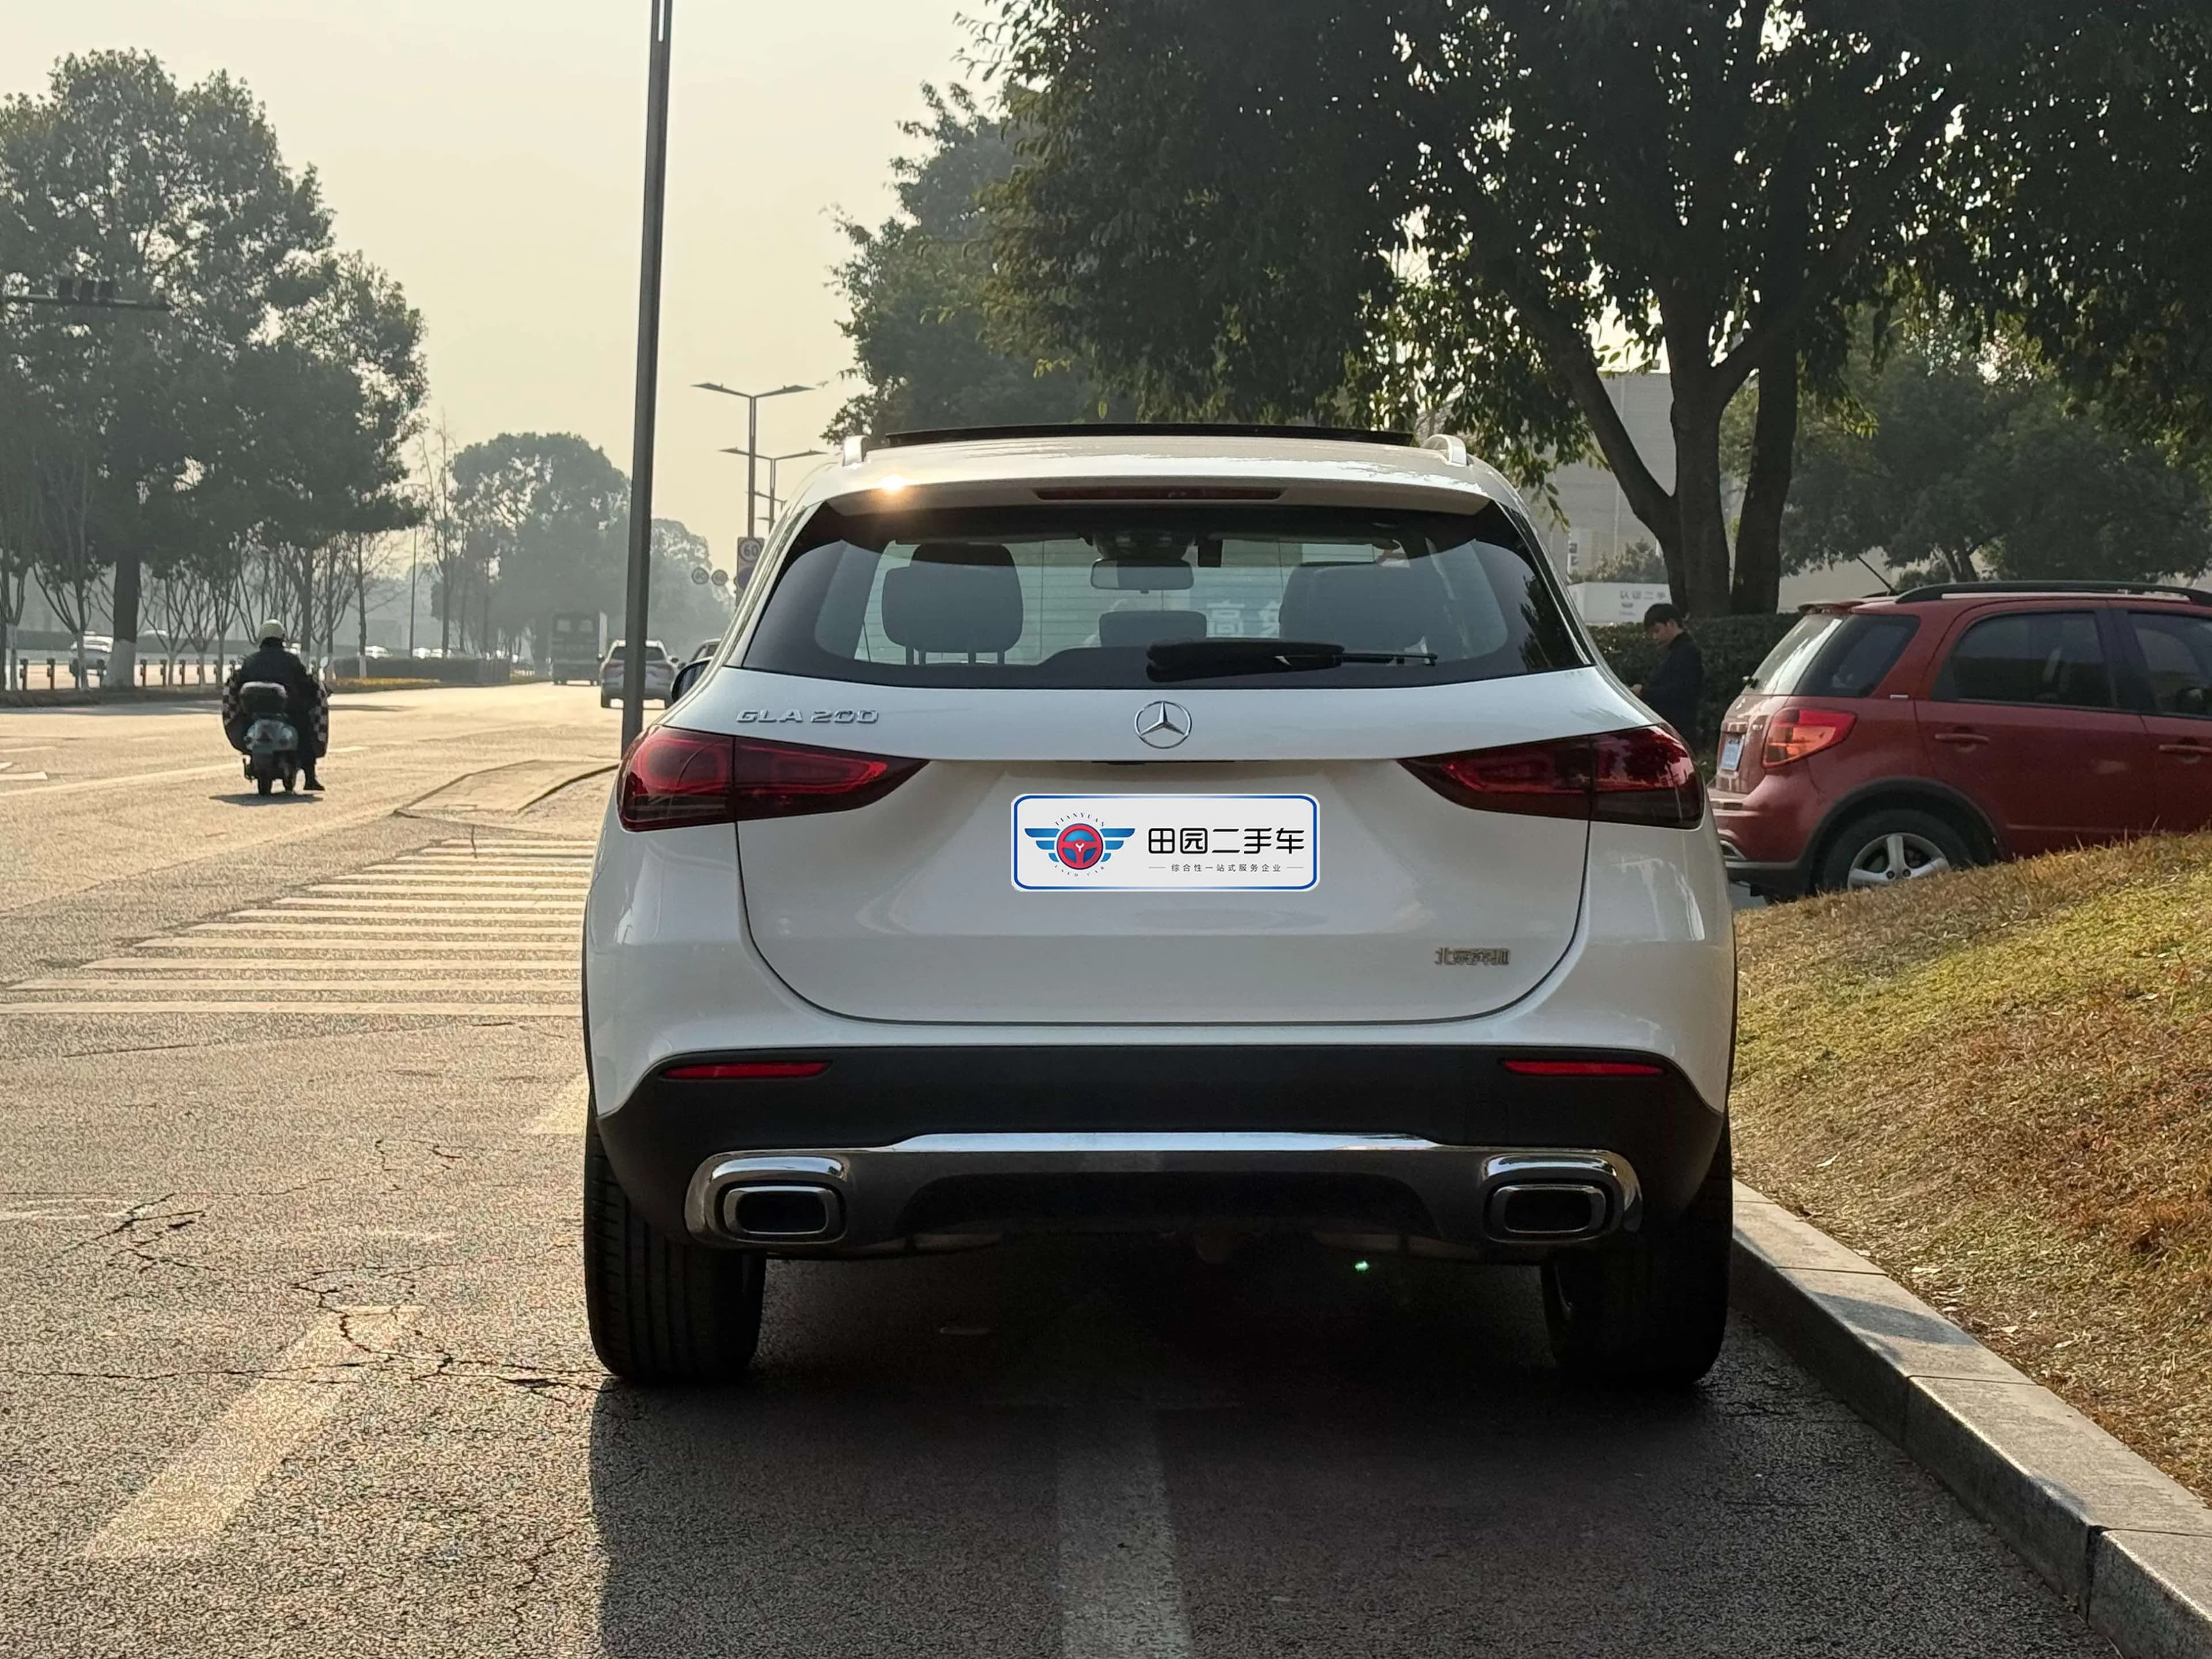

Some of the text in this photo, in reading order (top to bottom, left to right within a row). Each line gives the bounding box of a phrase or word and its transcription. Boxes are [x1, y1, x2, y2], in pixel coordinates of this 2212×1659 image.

[744, 544, 759, 557] 60
[736, 709, 878, 724] GLA 200
